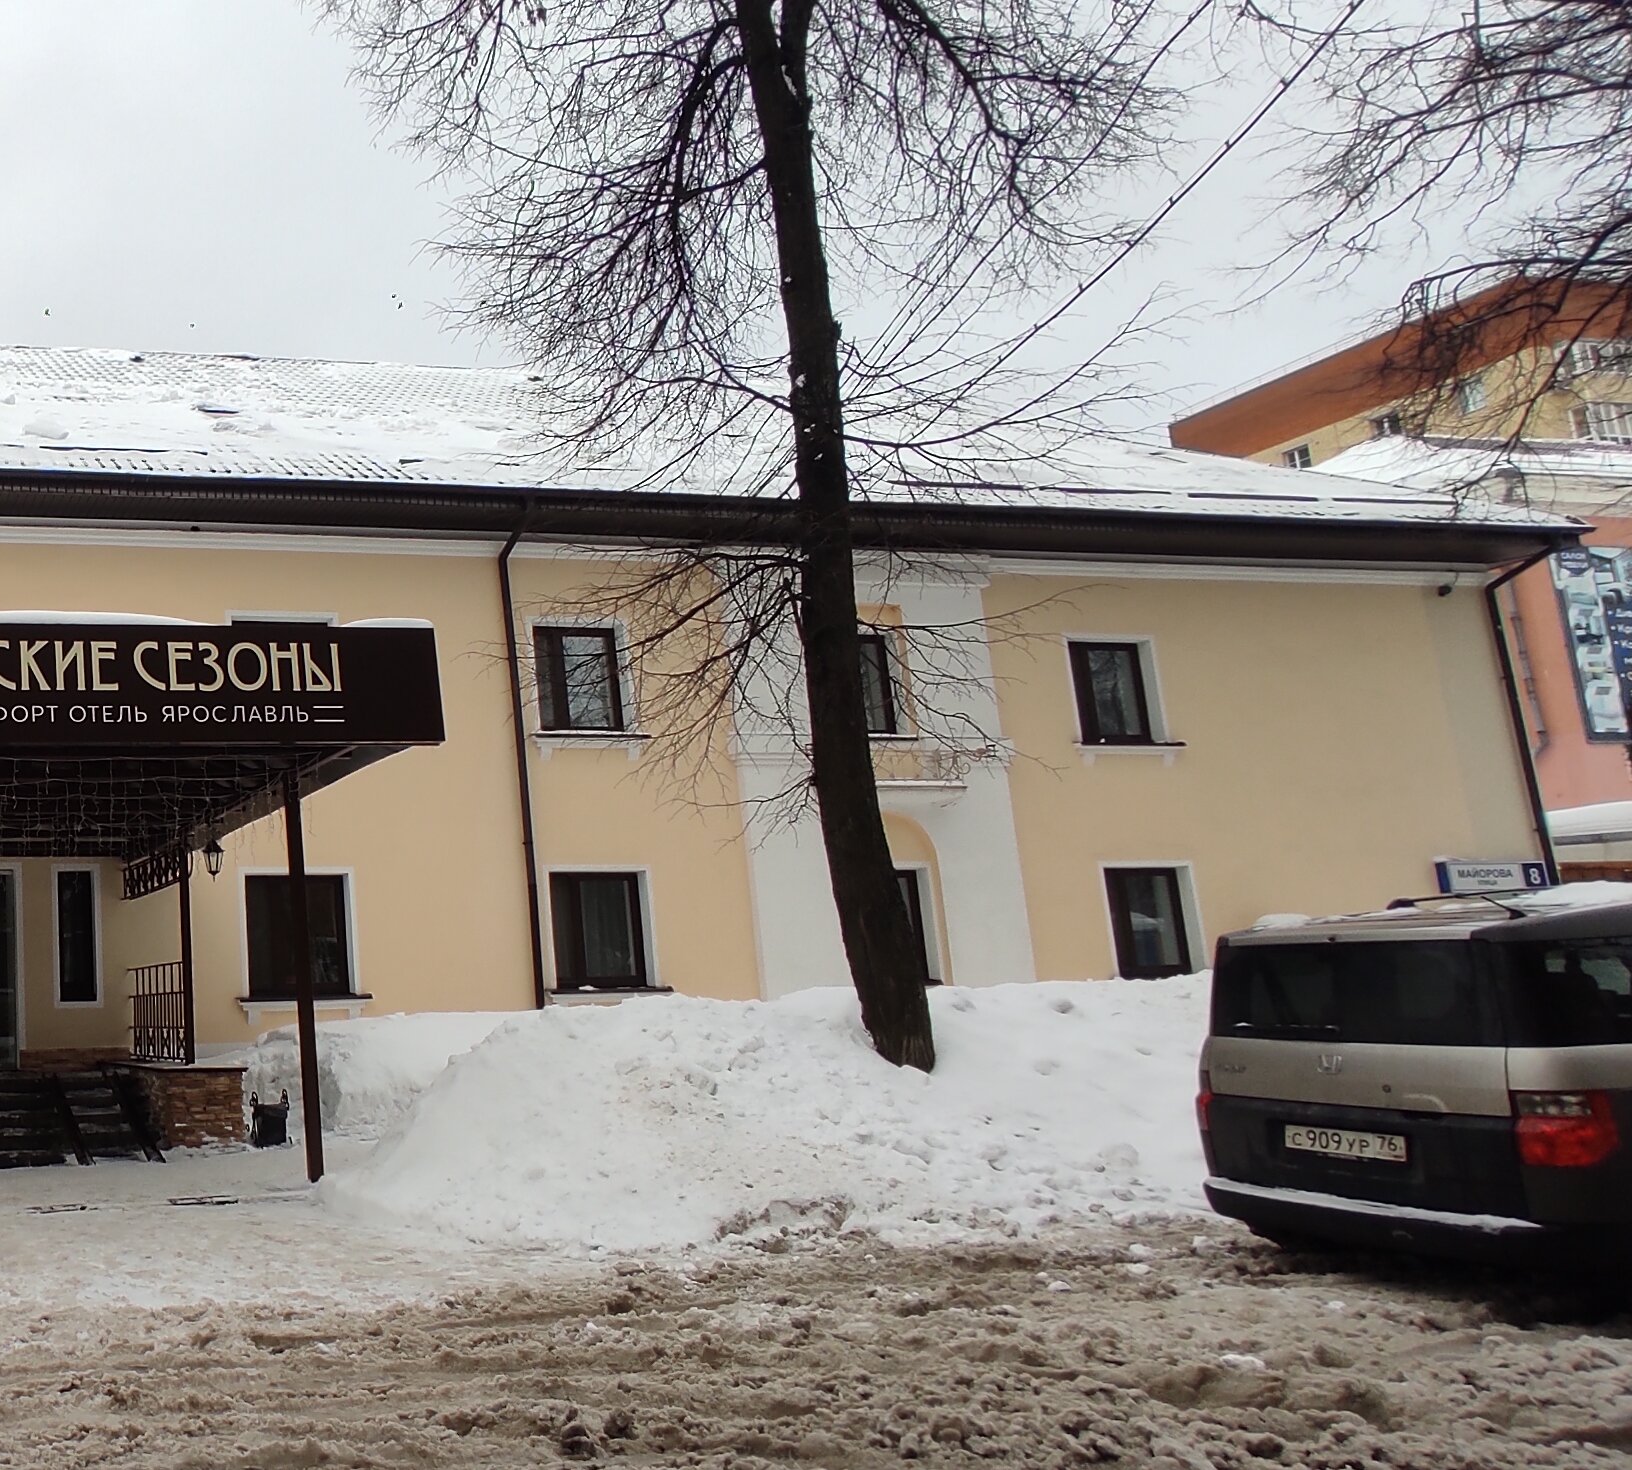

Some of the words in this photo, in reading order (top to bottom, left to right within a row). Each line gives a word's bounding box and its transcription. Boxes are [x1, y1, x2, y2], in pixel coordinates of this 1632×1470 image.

[133, 640, 342, 692] СЕЗОНЫ
[68, 704, 148, 723] ОТЕЛЬ
[161, 704, 309, 723] ЯРОСЛАВЛЬ
[1457, 867, 1514, 878] МАЙОРОВА
[1528, 868, 1541, 884] 8
